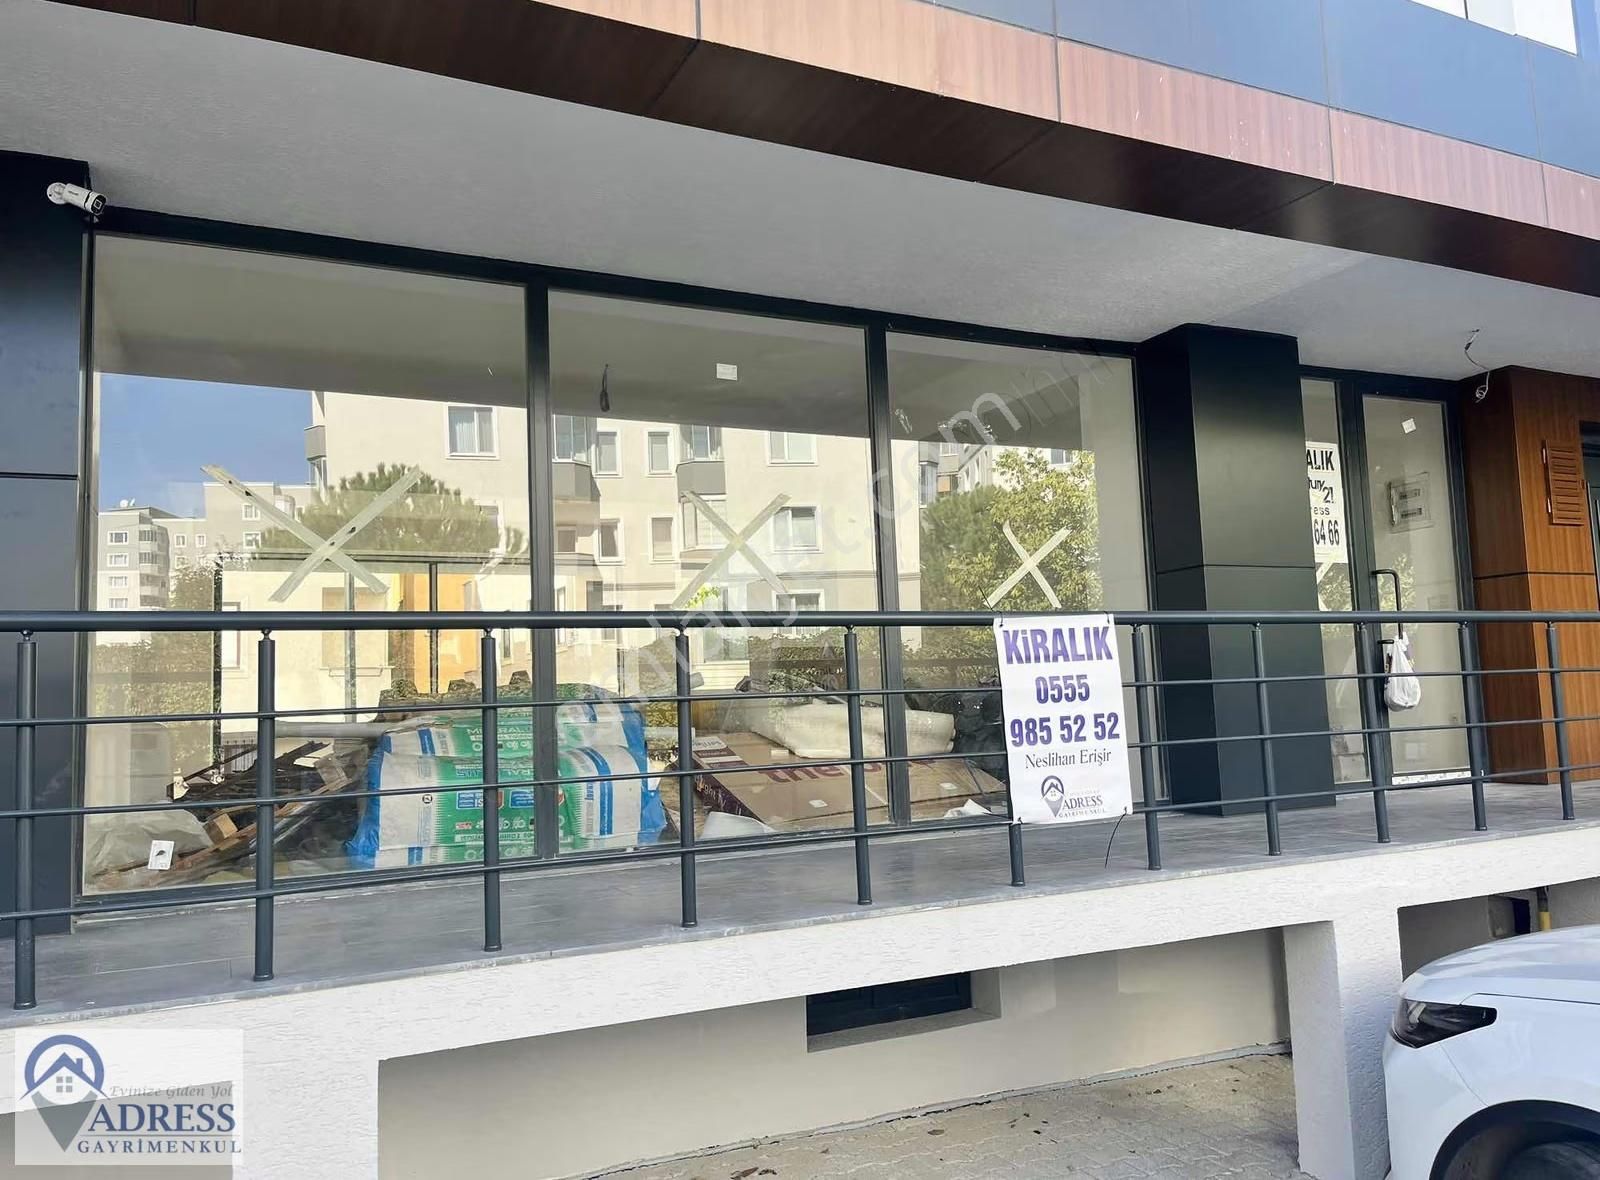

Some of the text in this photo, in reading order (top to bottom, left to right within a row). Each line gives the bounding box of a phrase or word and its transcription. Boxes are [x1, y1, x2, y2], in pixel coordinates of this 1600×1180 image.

[1306, 448, 1335, 471] ALIK
[1327, 519, 1340, 546] 66
[1035, 674, 1090, 704] 0555
[1010, 711, 1120, 747] 985 52 52
[1025, 748, 1112, 769] Neslihan Erişir
[1062, 794, 1104, 810] ADRESS
